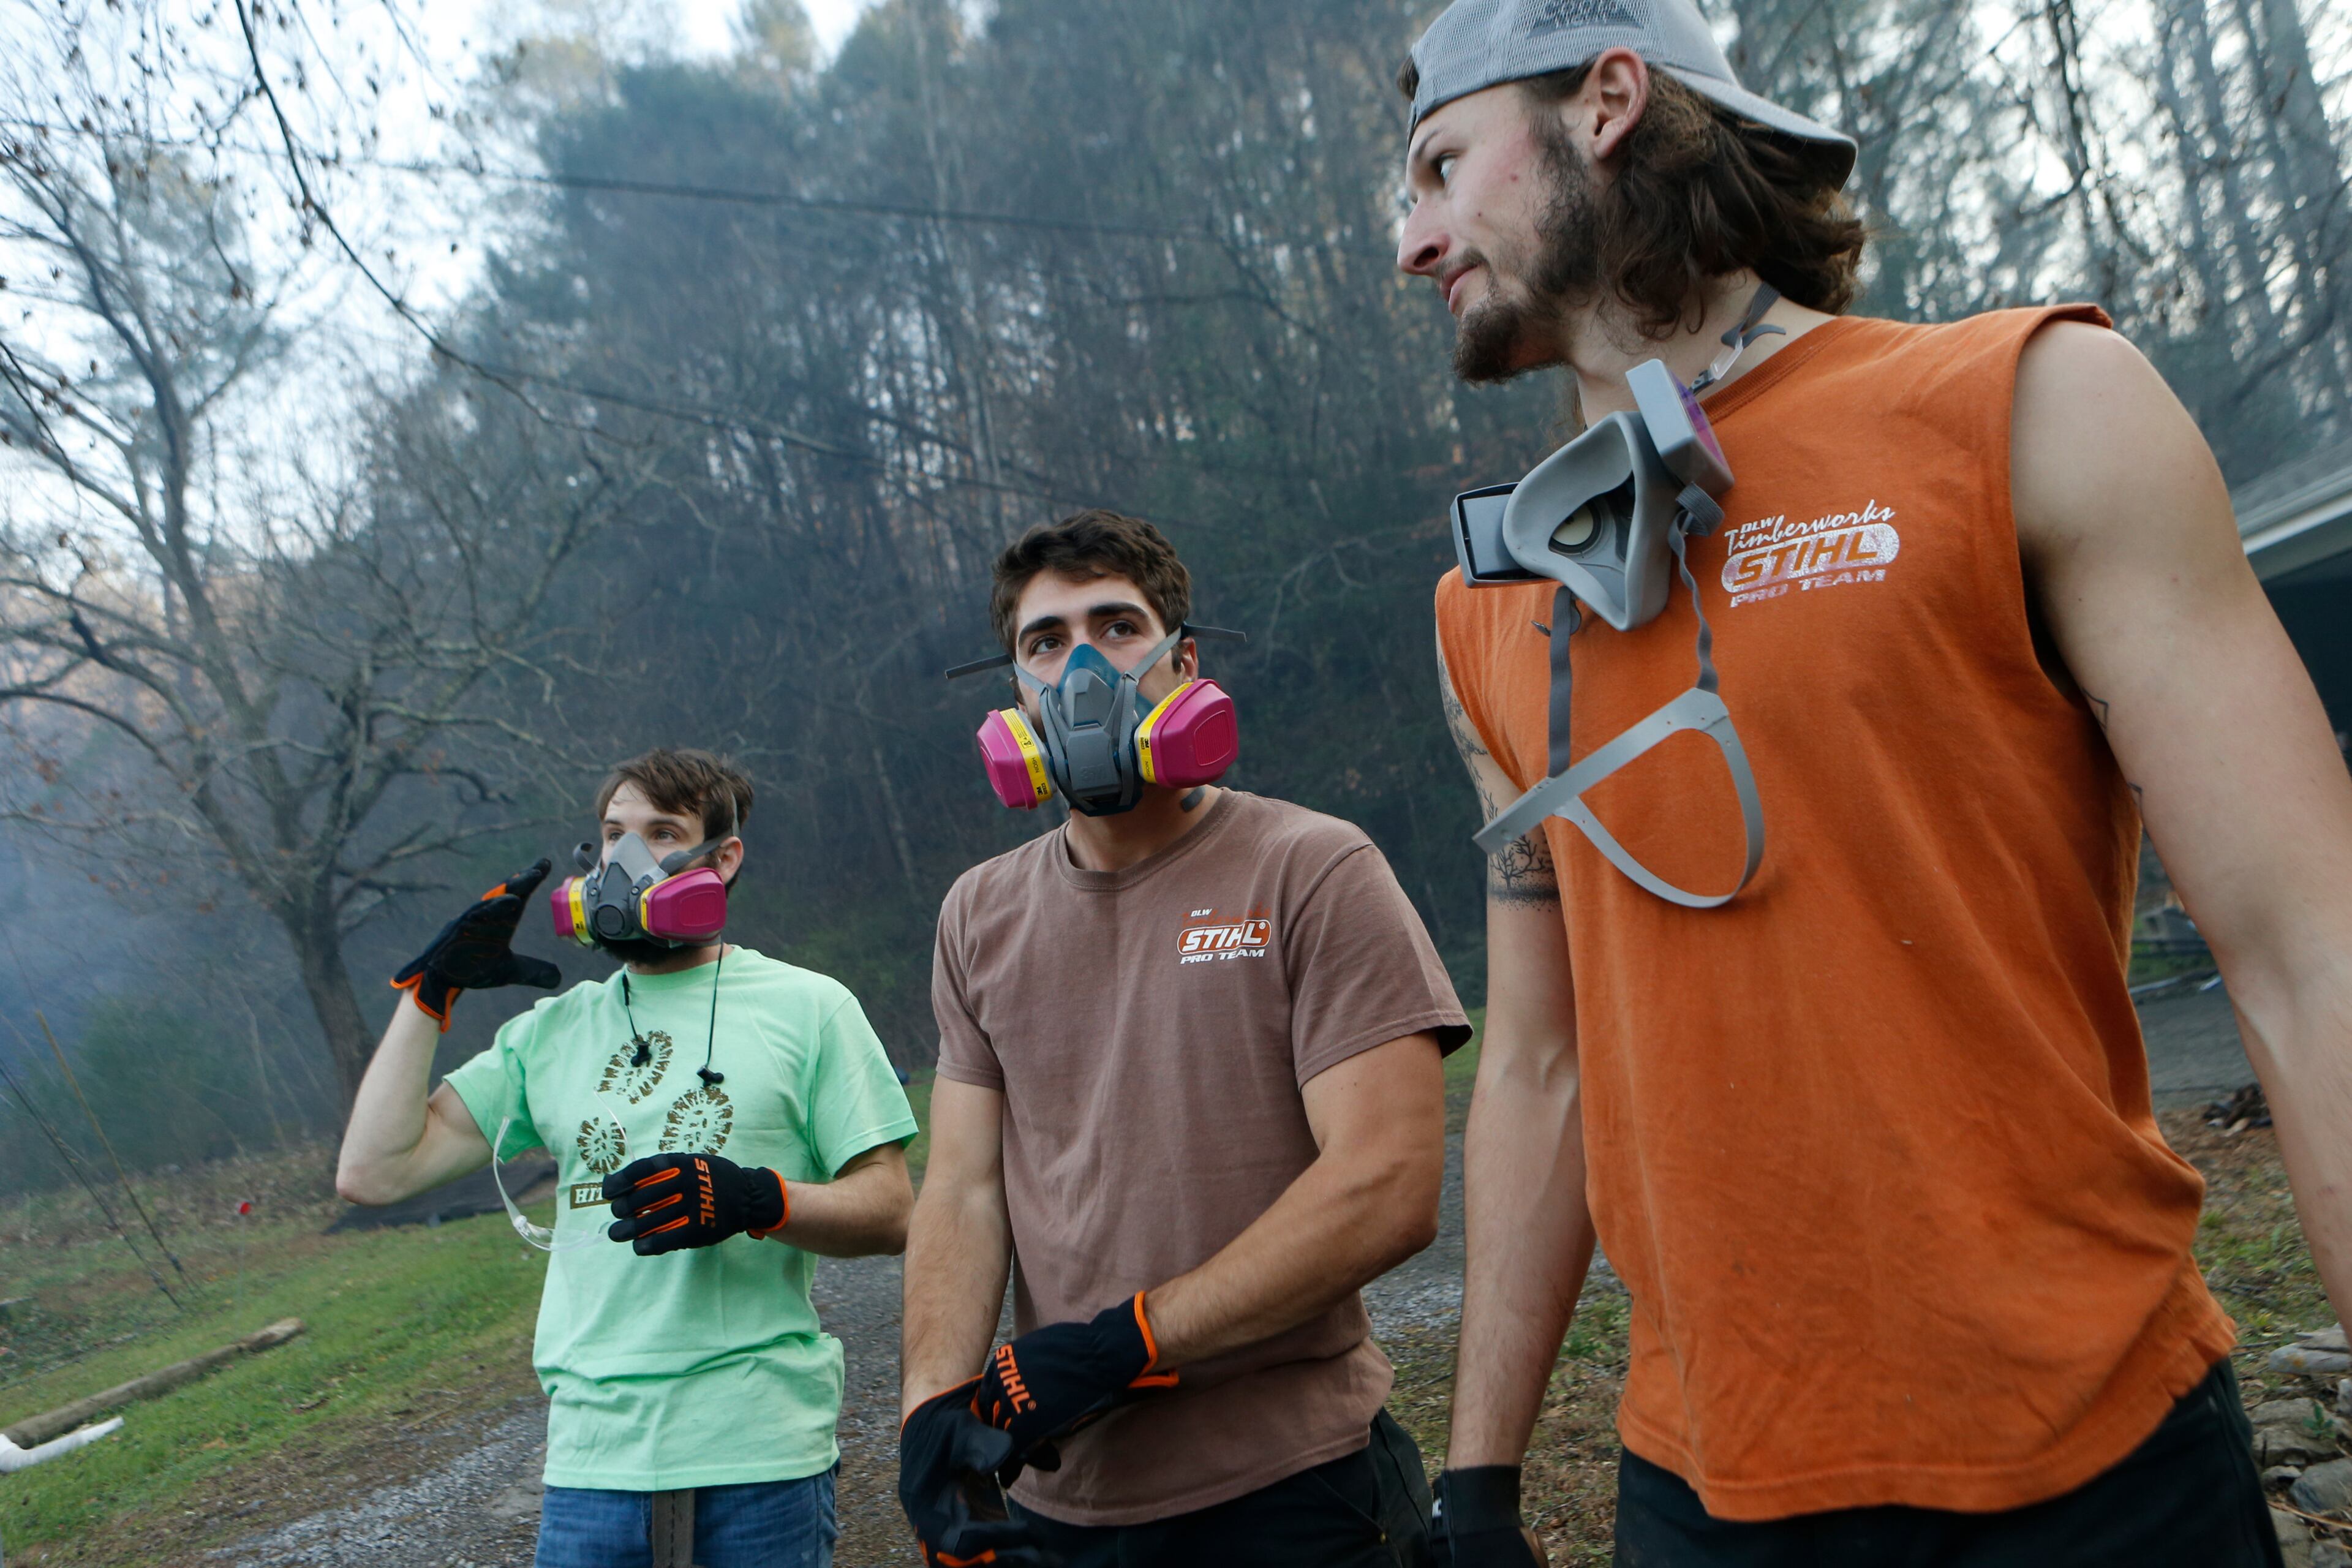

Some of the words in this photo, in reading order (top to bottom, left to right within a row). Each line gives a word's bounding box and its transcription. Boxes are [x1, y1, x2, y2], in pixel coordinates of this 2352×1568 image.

[1724, 499, 1896, 556] Timberworks
[1740, 516, 1776, 533] DLW
[1733, 531, 1878, 586] STIHL
[1730, 584, 1789, 608] PRO
[1799, 569, 1887, 591] TEAM
[1144, 738, 1150, 748] 3M
[1036, 786, 1043, 795] 3M
[1191, 908, 1212, 917] DLW
[1182, 923, 1262, 952] STIHL
[1180, 953, 1213, 964] PRO
[1219, 949, 1265, 960] TEAM
[694, 1157, 715, 1225] STIHL
[995, 1344, 1030, 1414] STIHL
